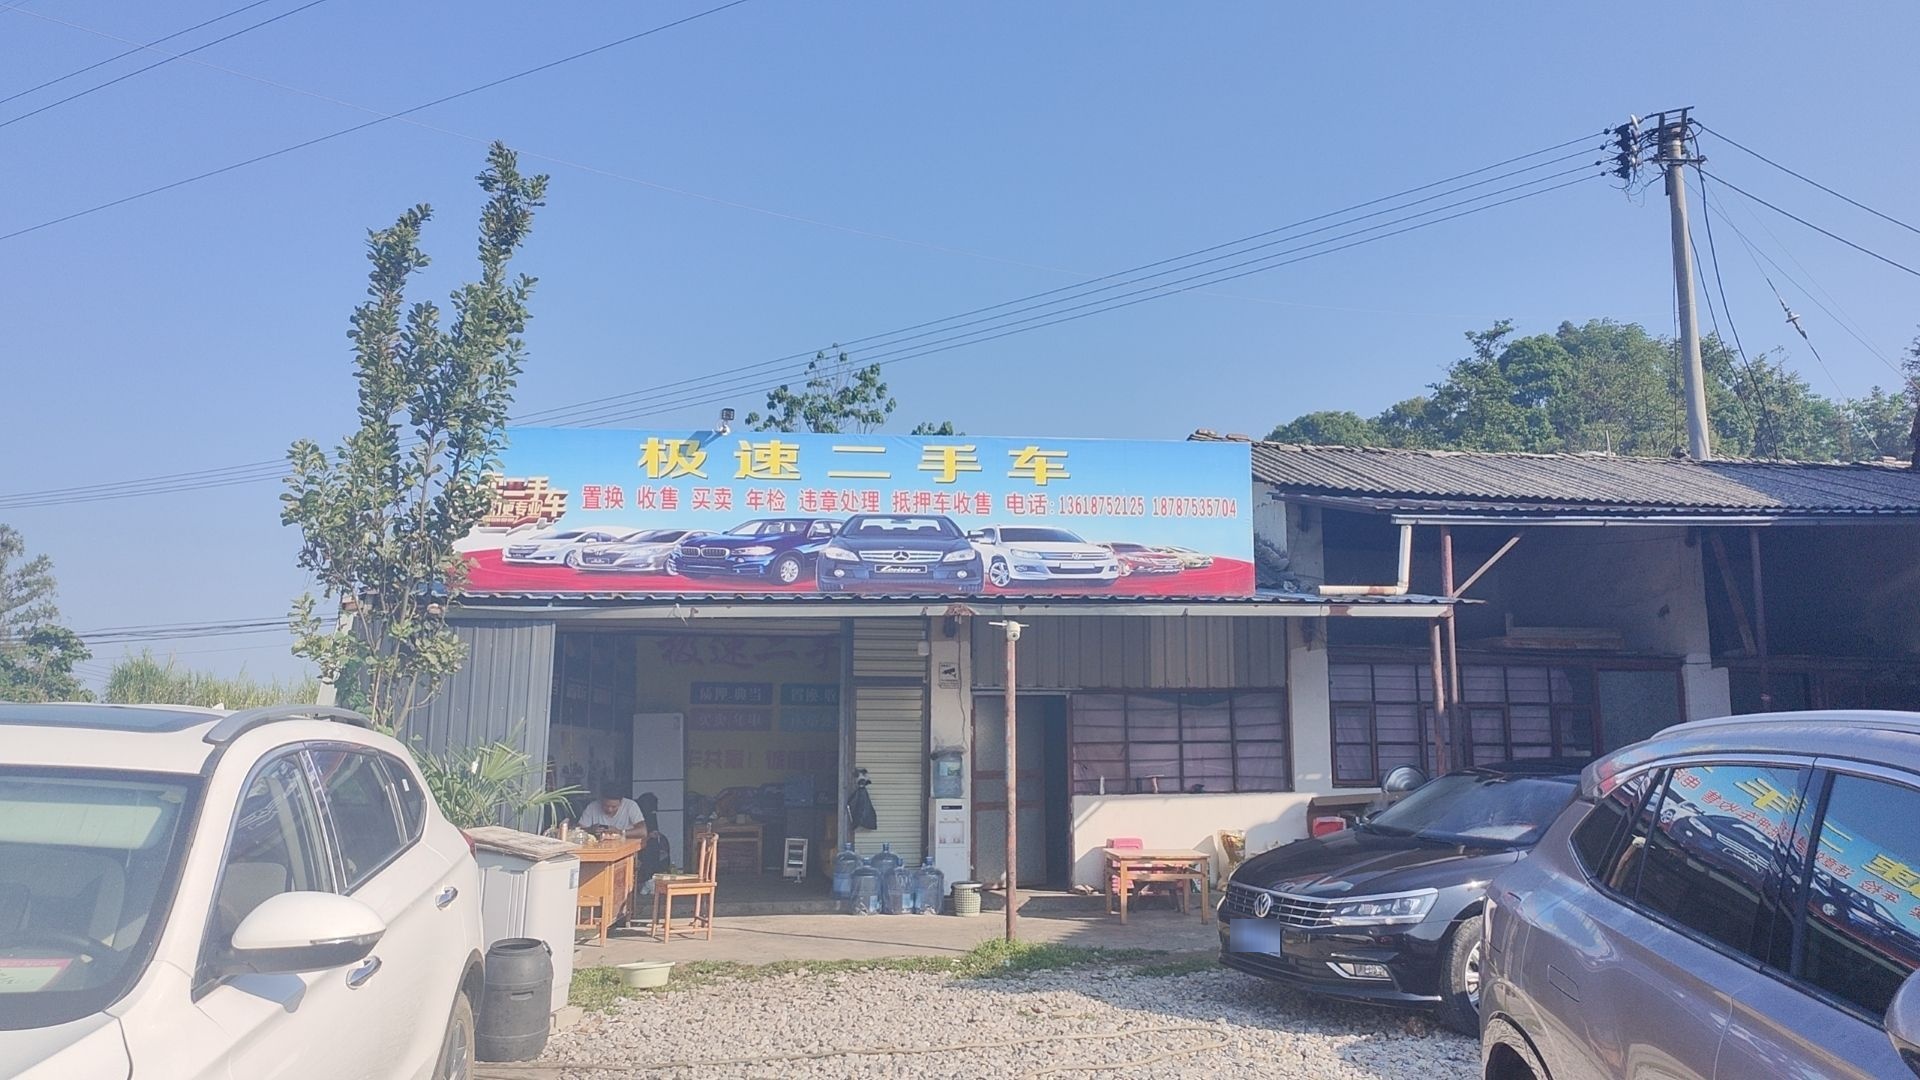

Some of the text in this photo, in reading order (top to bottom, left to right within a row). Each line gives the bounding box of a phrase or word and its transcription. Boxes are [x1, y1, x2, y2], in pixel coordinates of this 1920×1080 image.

[638, 437, 1071, 486] 极速二手车
[582, 485, 624, 511] 置换
[637, 486, 679, 510] 收售
[692, 487, 732, 511] 买卖
[746, 488, 786, 512] 年检
[799, 489, 880, 514] 违章处理
[892, 491, 992, 516] 抵押车收售
[1152, 497, 1237, 517] 18787535704
